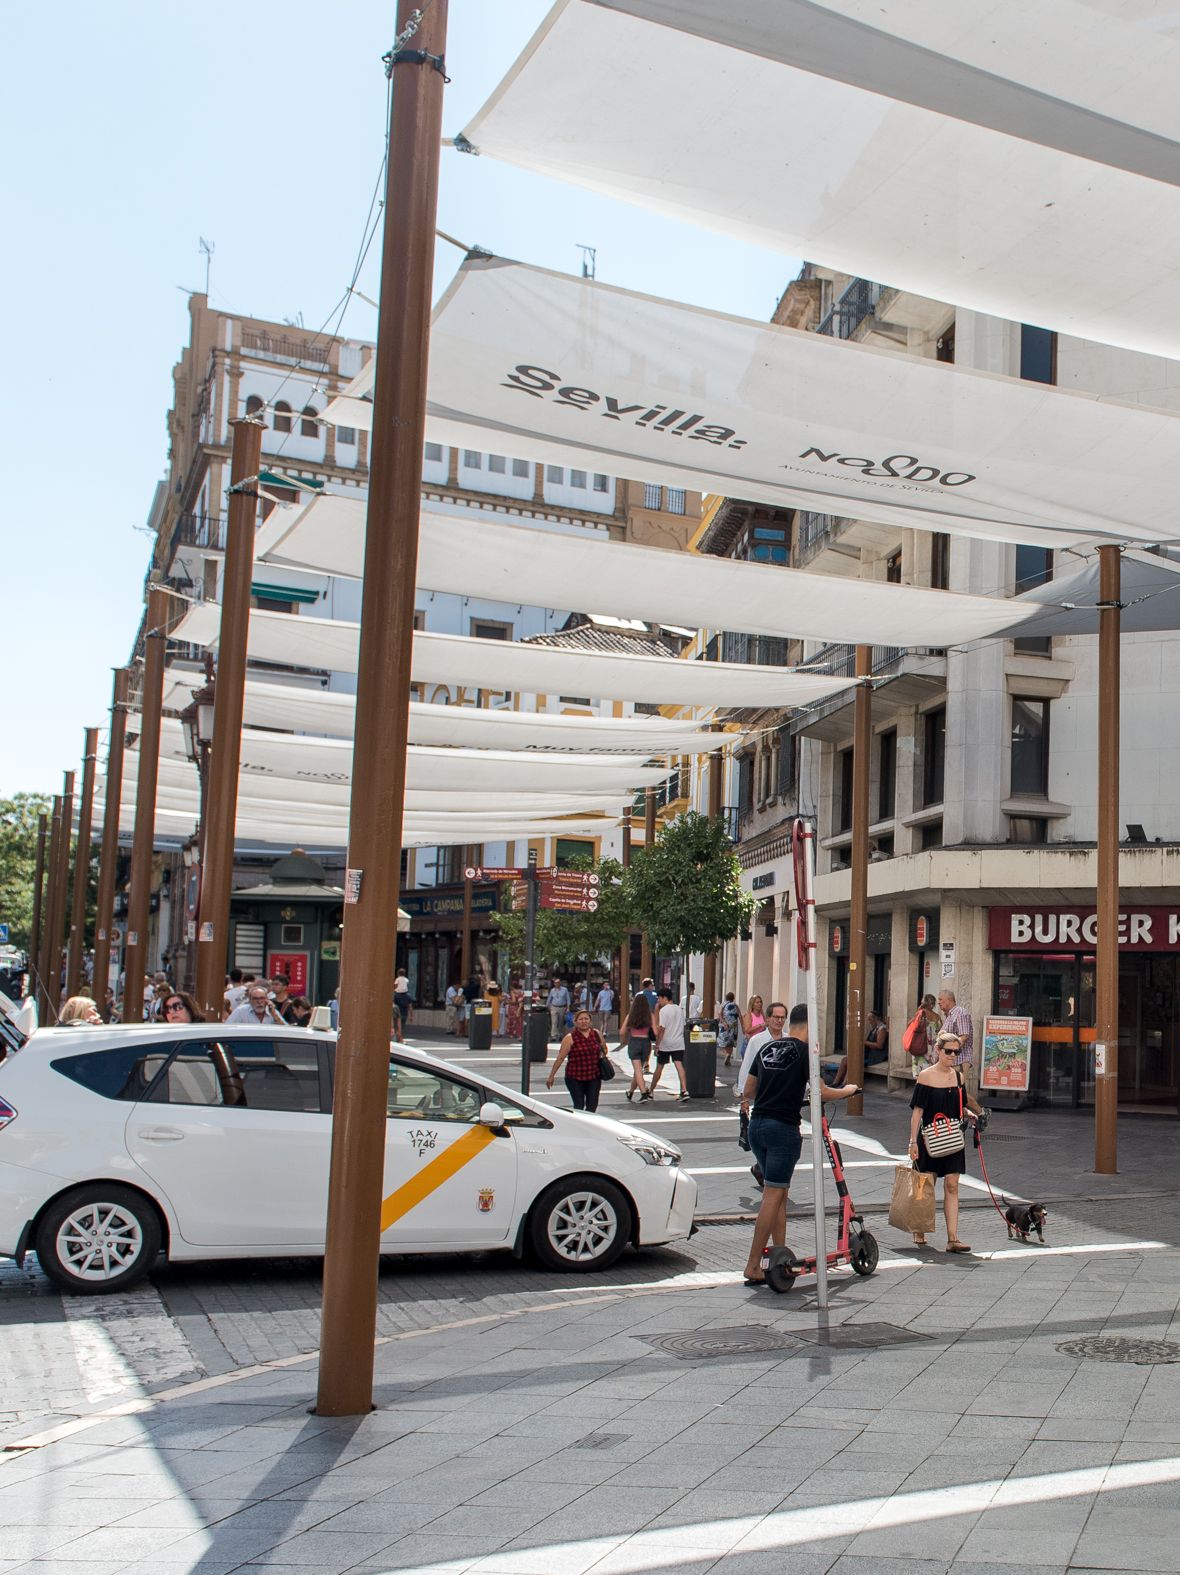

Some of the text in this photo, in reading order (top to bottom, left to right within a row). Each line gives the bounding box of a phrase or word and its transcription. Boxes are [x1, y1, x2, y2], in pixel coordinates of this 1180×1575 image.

[1010, 913, 1154, 944] BURGER
[408, 1129, 438, 1139] TAXI
[411, 1140, 435, 1148] 1746
[418, 1149, 426, 1157] F
